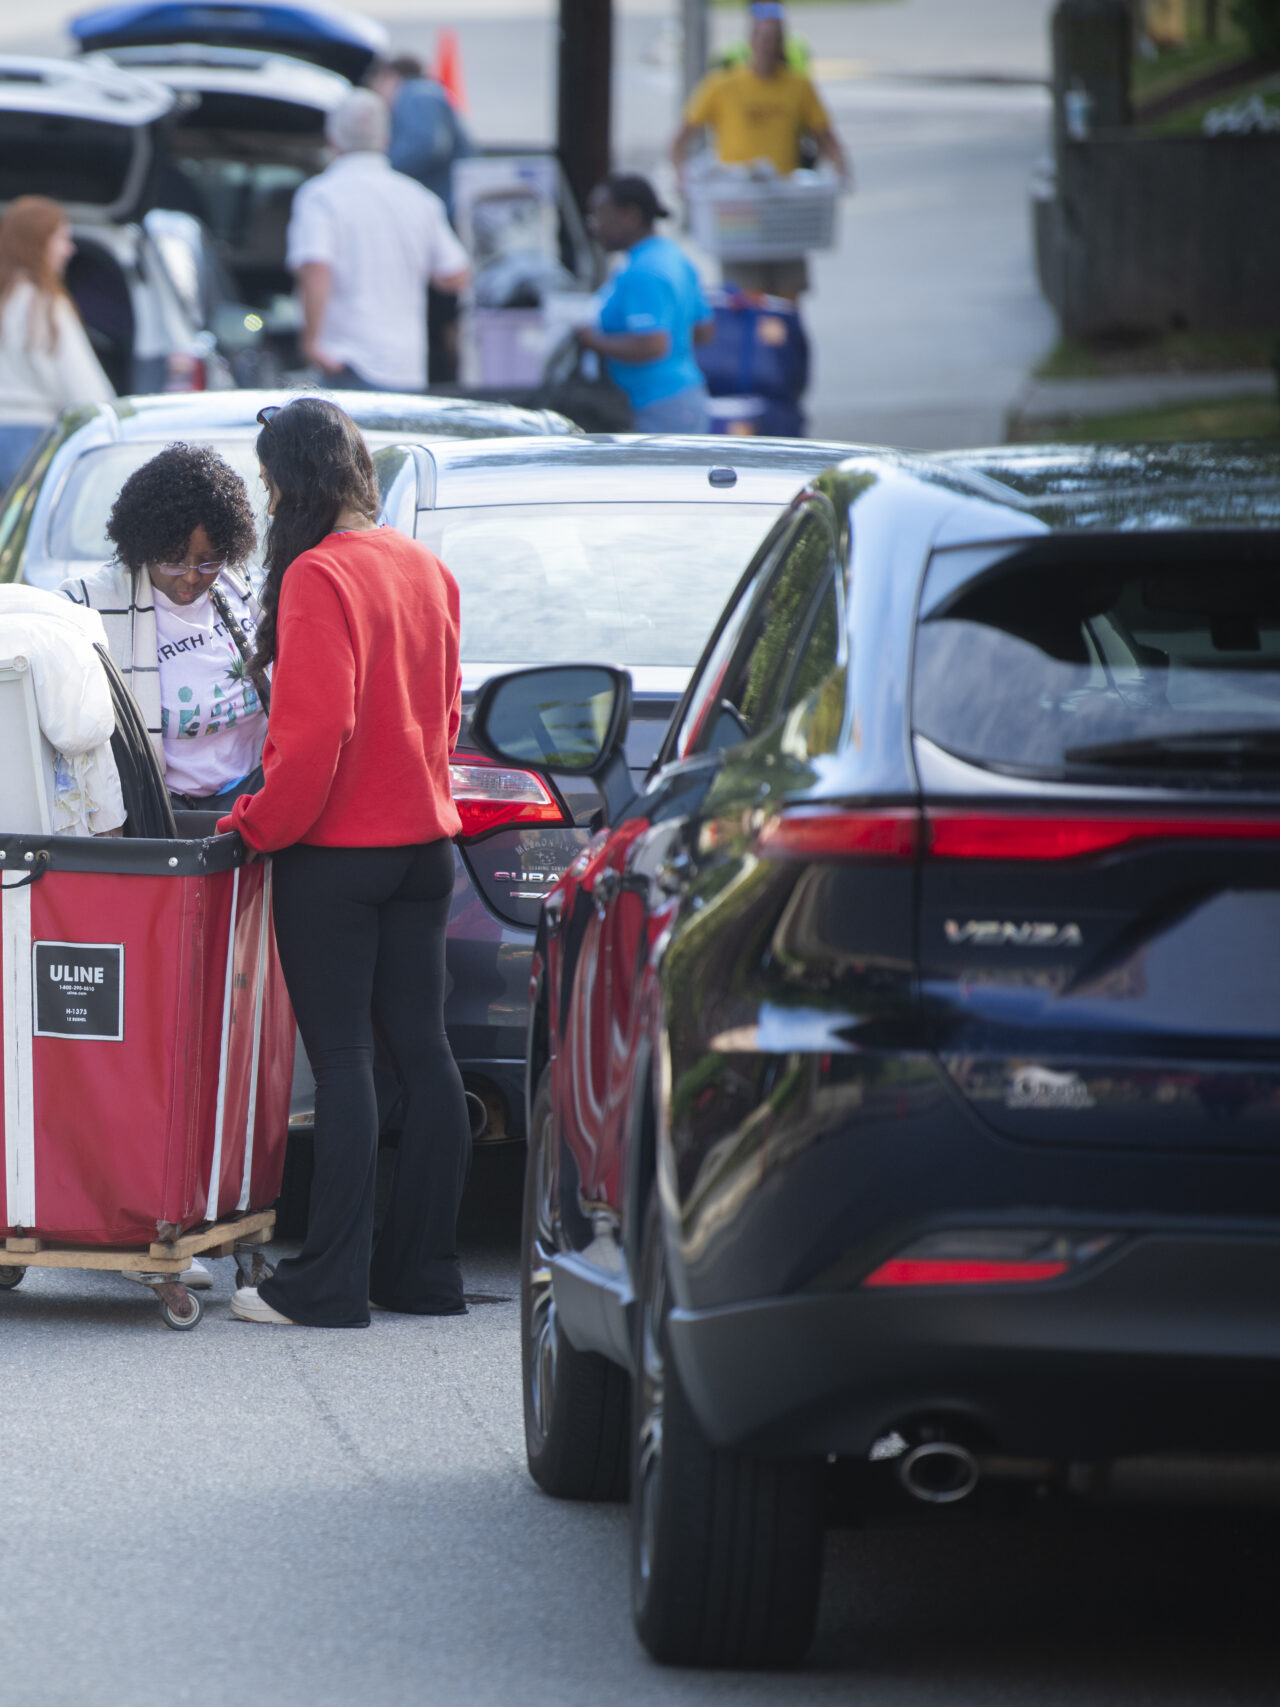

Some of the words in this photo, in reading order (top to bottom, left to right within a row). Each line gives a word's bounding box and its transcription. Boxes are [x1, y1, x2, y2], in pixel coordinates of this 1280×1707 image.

[494, 872, 560, 883] SUBA
[944, 920, 1083, 946] VENZA
[50, 964, 104, 984] ULINE
